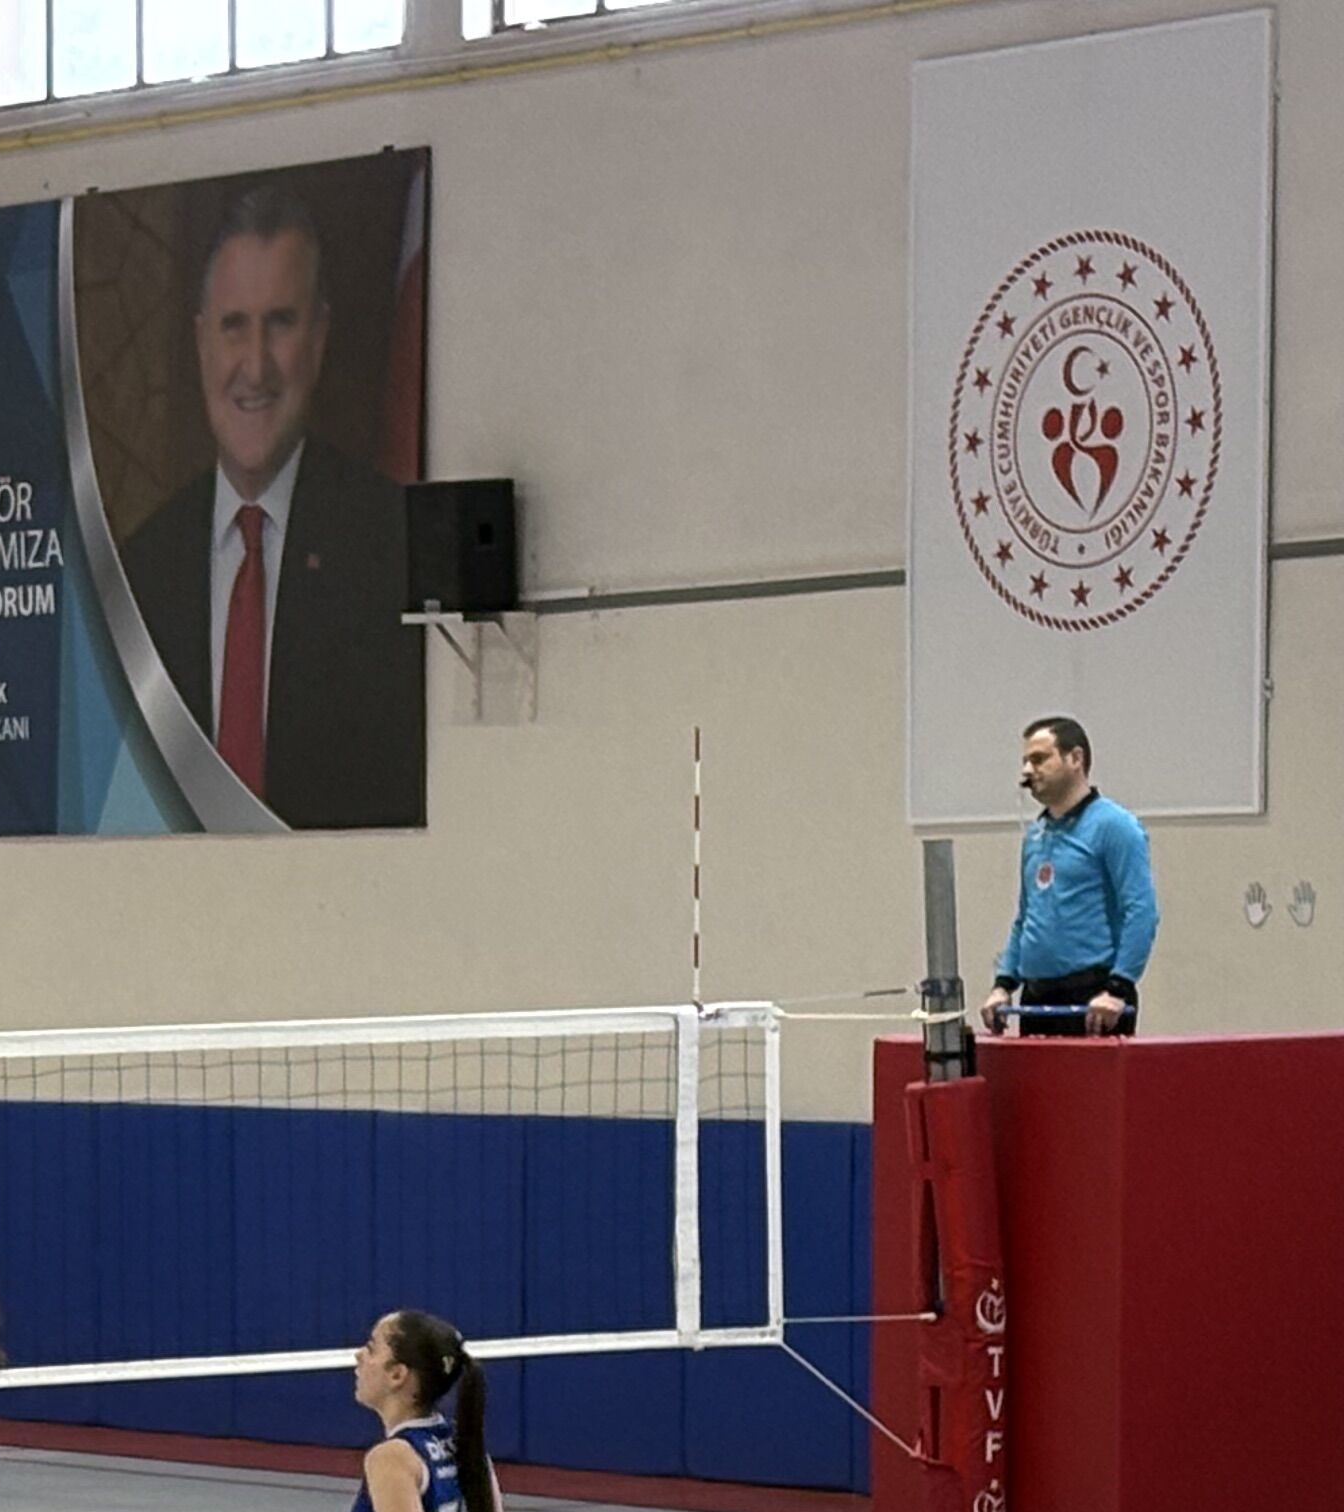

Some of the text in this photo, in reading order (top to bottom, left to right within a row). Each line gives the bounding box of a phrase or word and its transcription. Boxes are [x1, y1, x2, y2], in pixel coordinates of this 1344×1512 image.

[996, 305, 1170, 554] TÜRKİYE CUMHURİYETİ GENÇLİK VE SPOR BAKANLIĞI
[985, 1345, 1005, 1463] TVF
